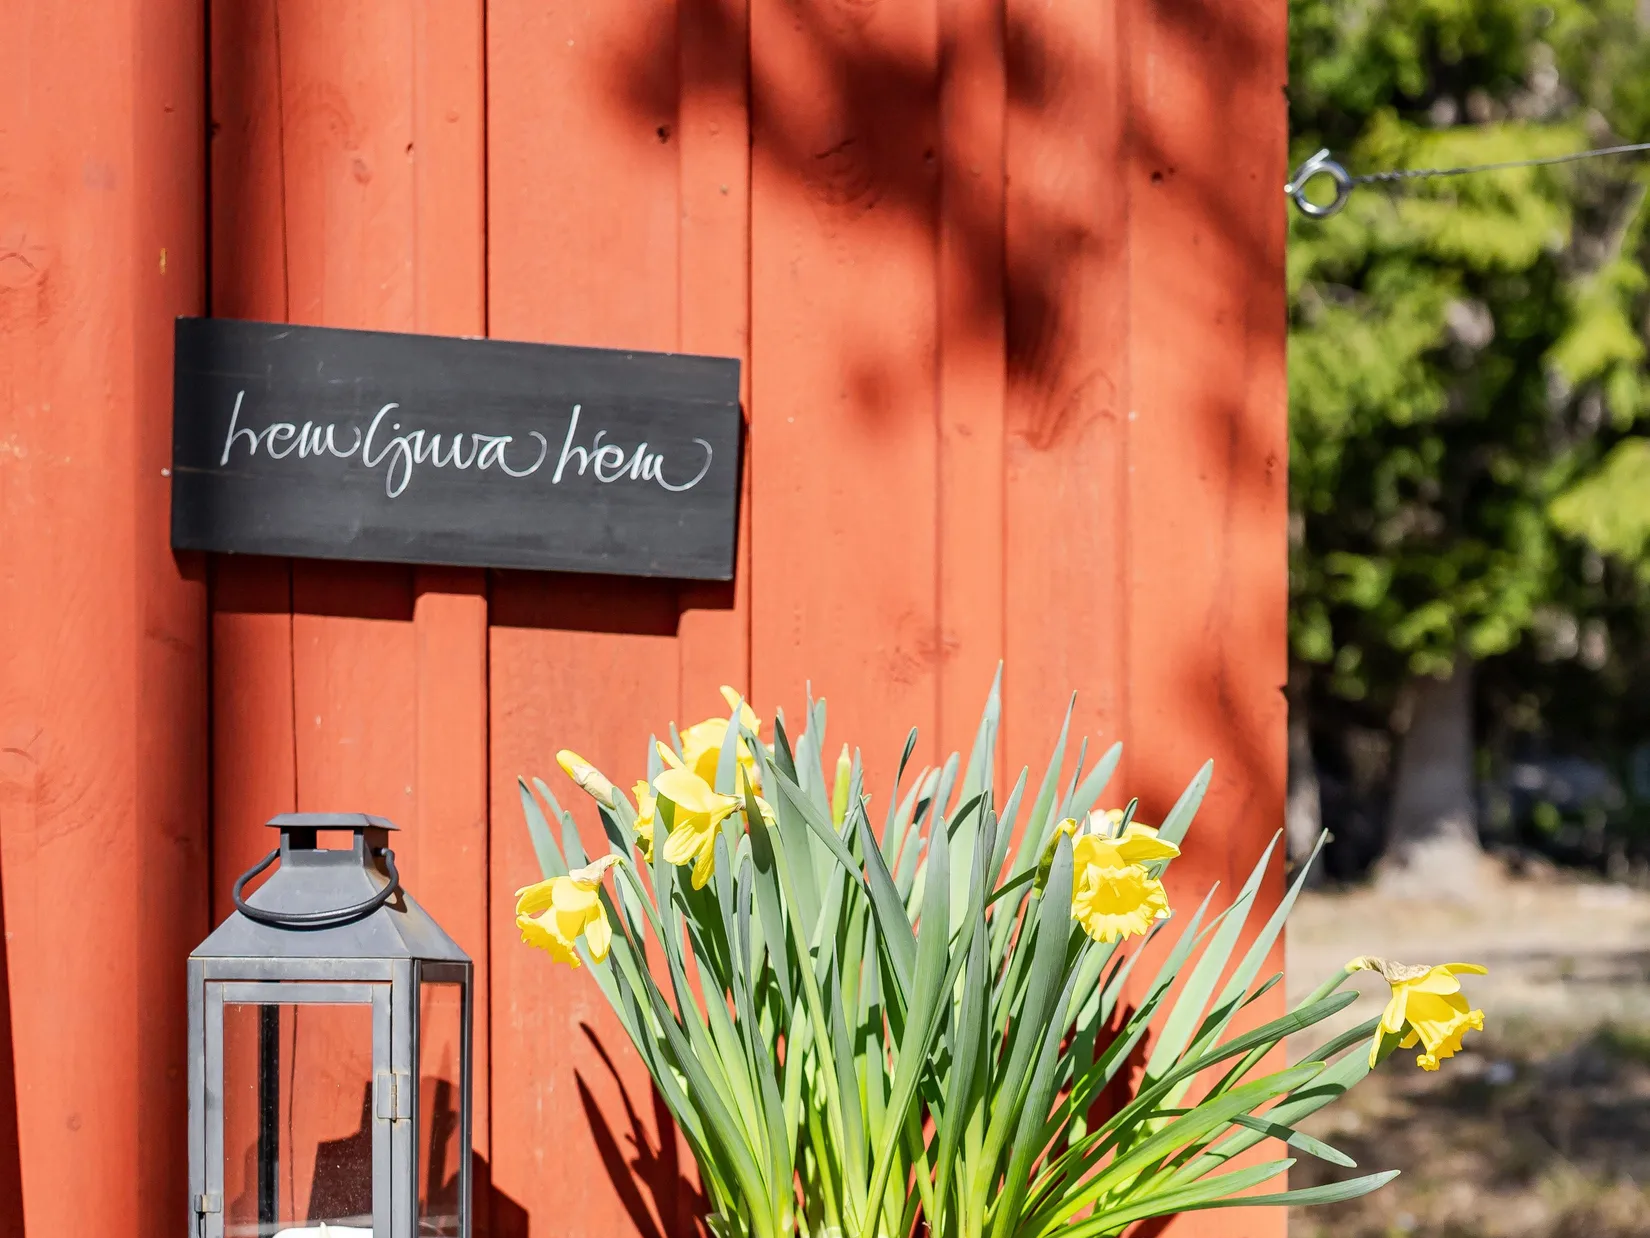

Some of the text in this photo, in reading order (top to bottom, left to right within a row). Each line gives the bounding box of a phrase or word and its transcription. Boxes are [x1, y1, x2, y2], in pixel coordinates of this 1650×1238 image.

[221, 390, 712, 498] hem ljuva hem
